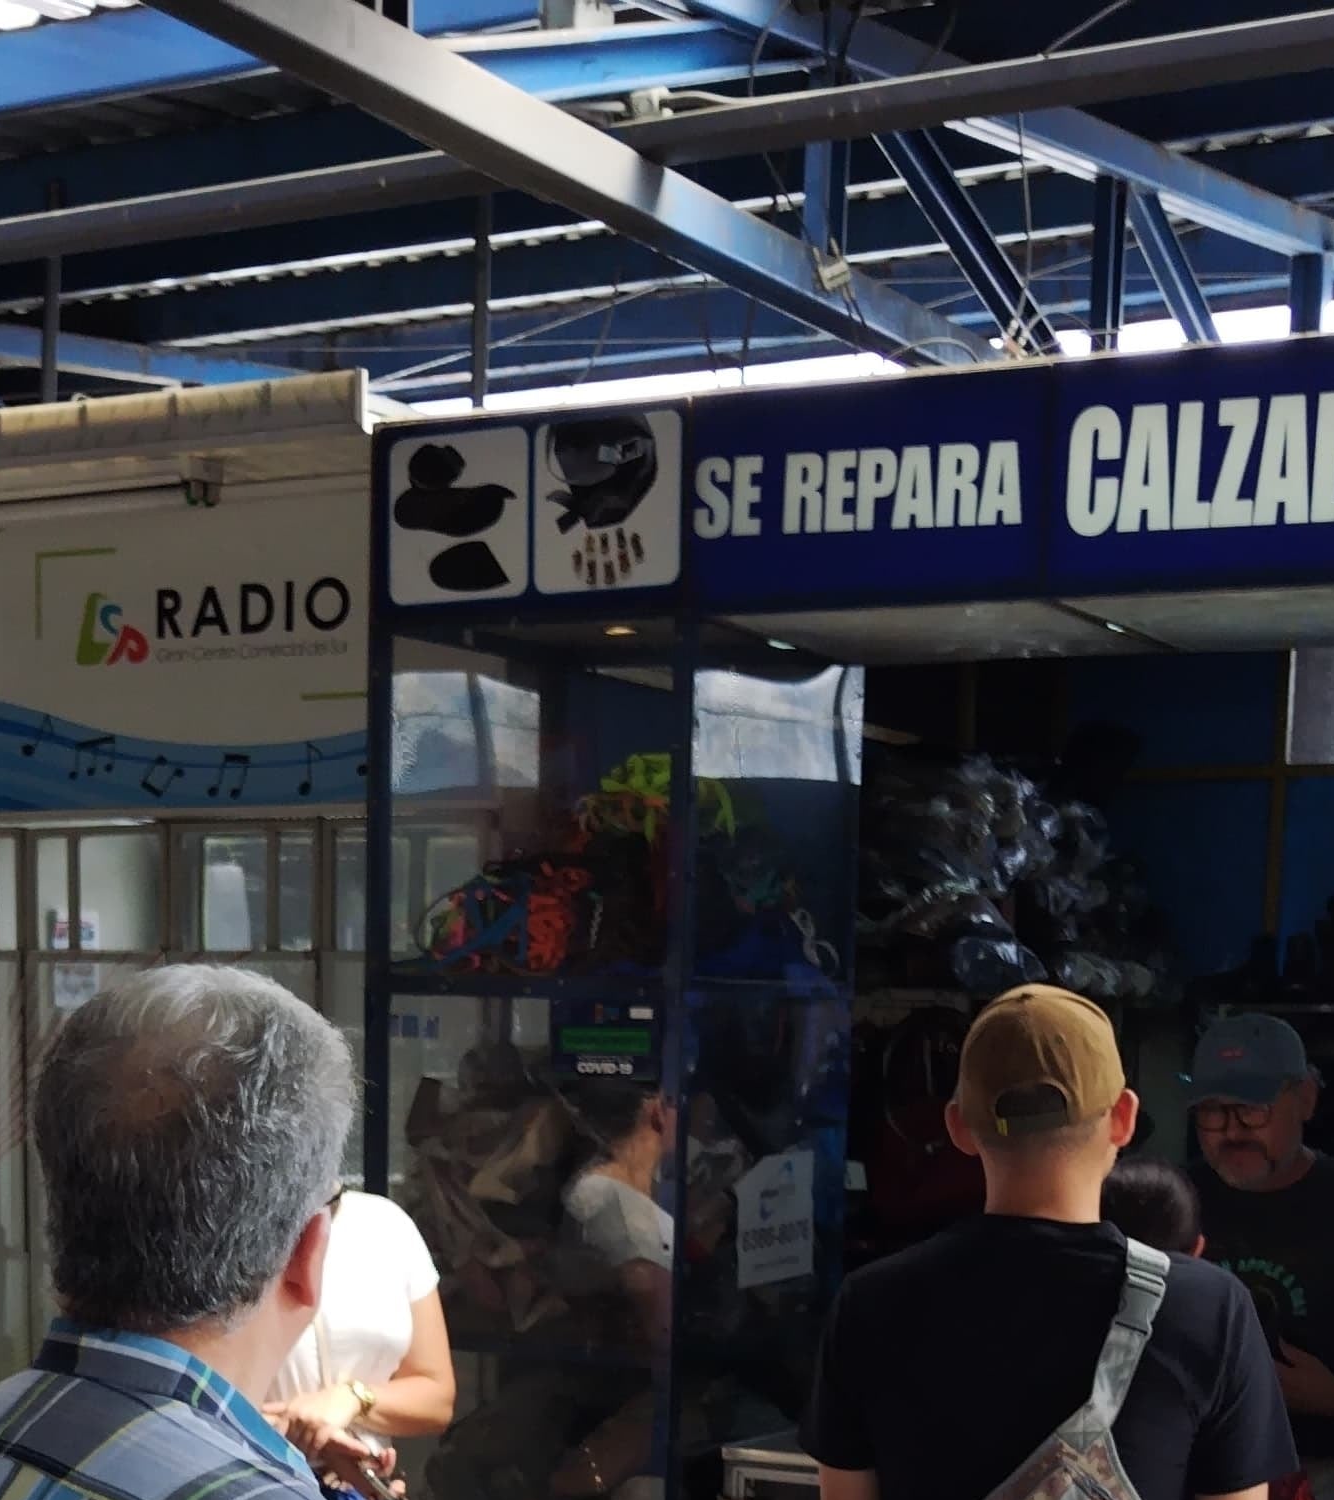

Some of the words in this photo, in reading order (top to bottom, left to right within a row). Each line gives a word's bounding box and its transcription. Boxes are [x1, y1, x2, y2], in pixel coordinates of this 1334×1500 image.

[693, 456, 762, 541] SE
[782, 440, 1023, 536] REPARA
[154, 576, 352, 640] RADIO
[576, 1060, 634, 1076] COVID-19
